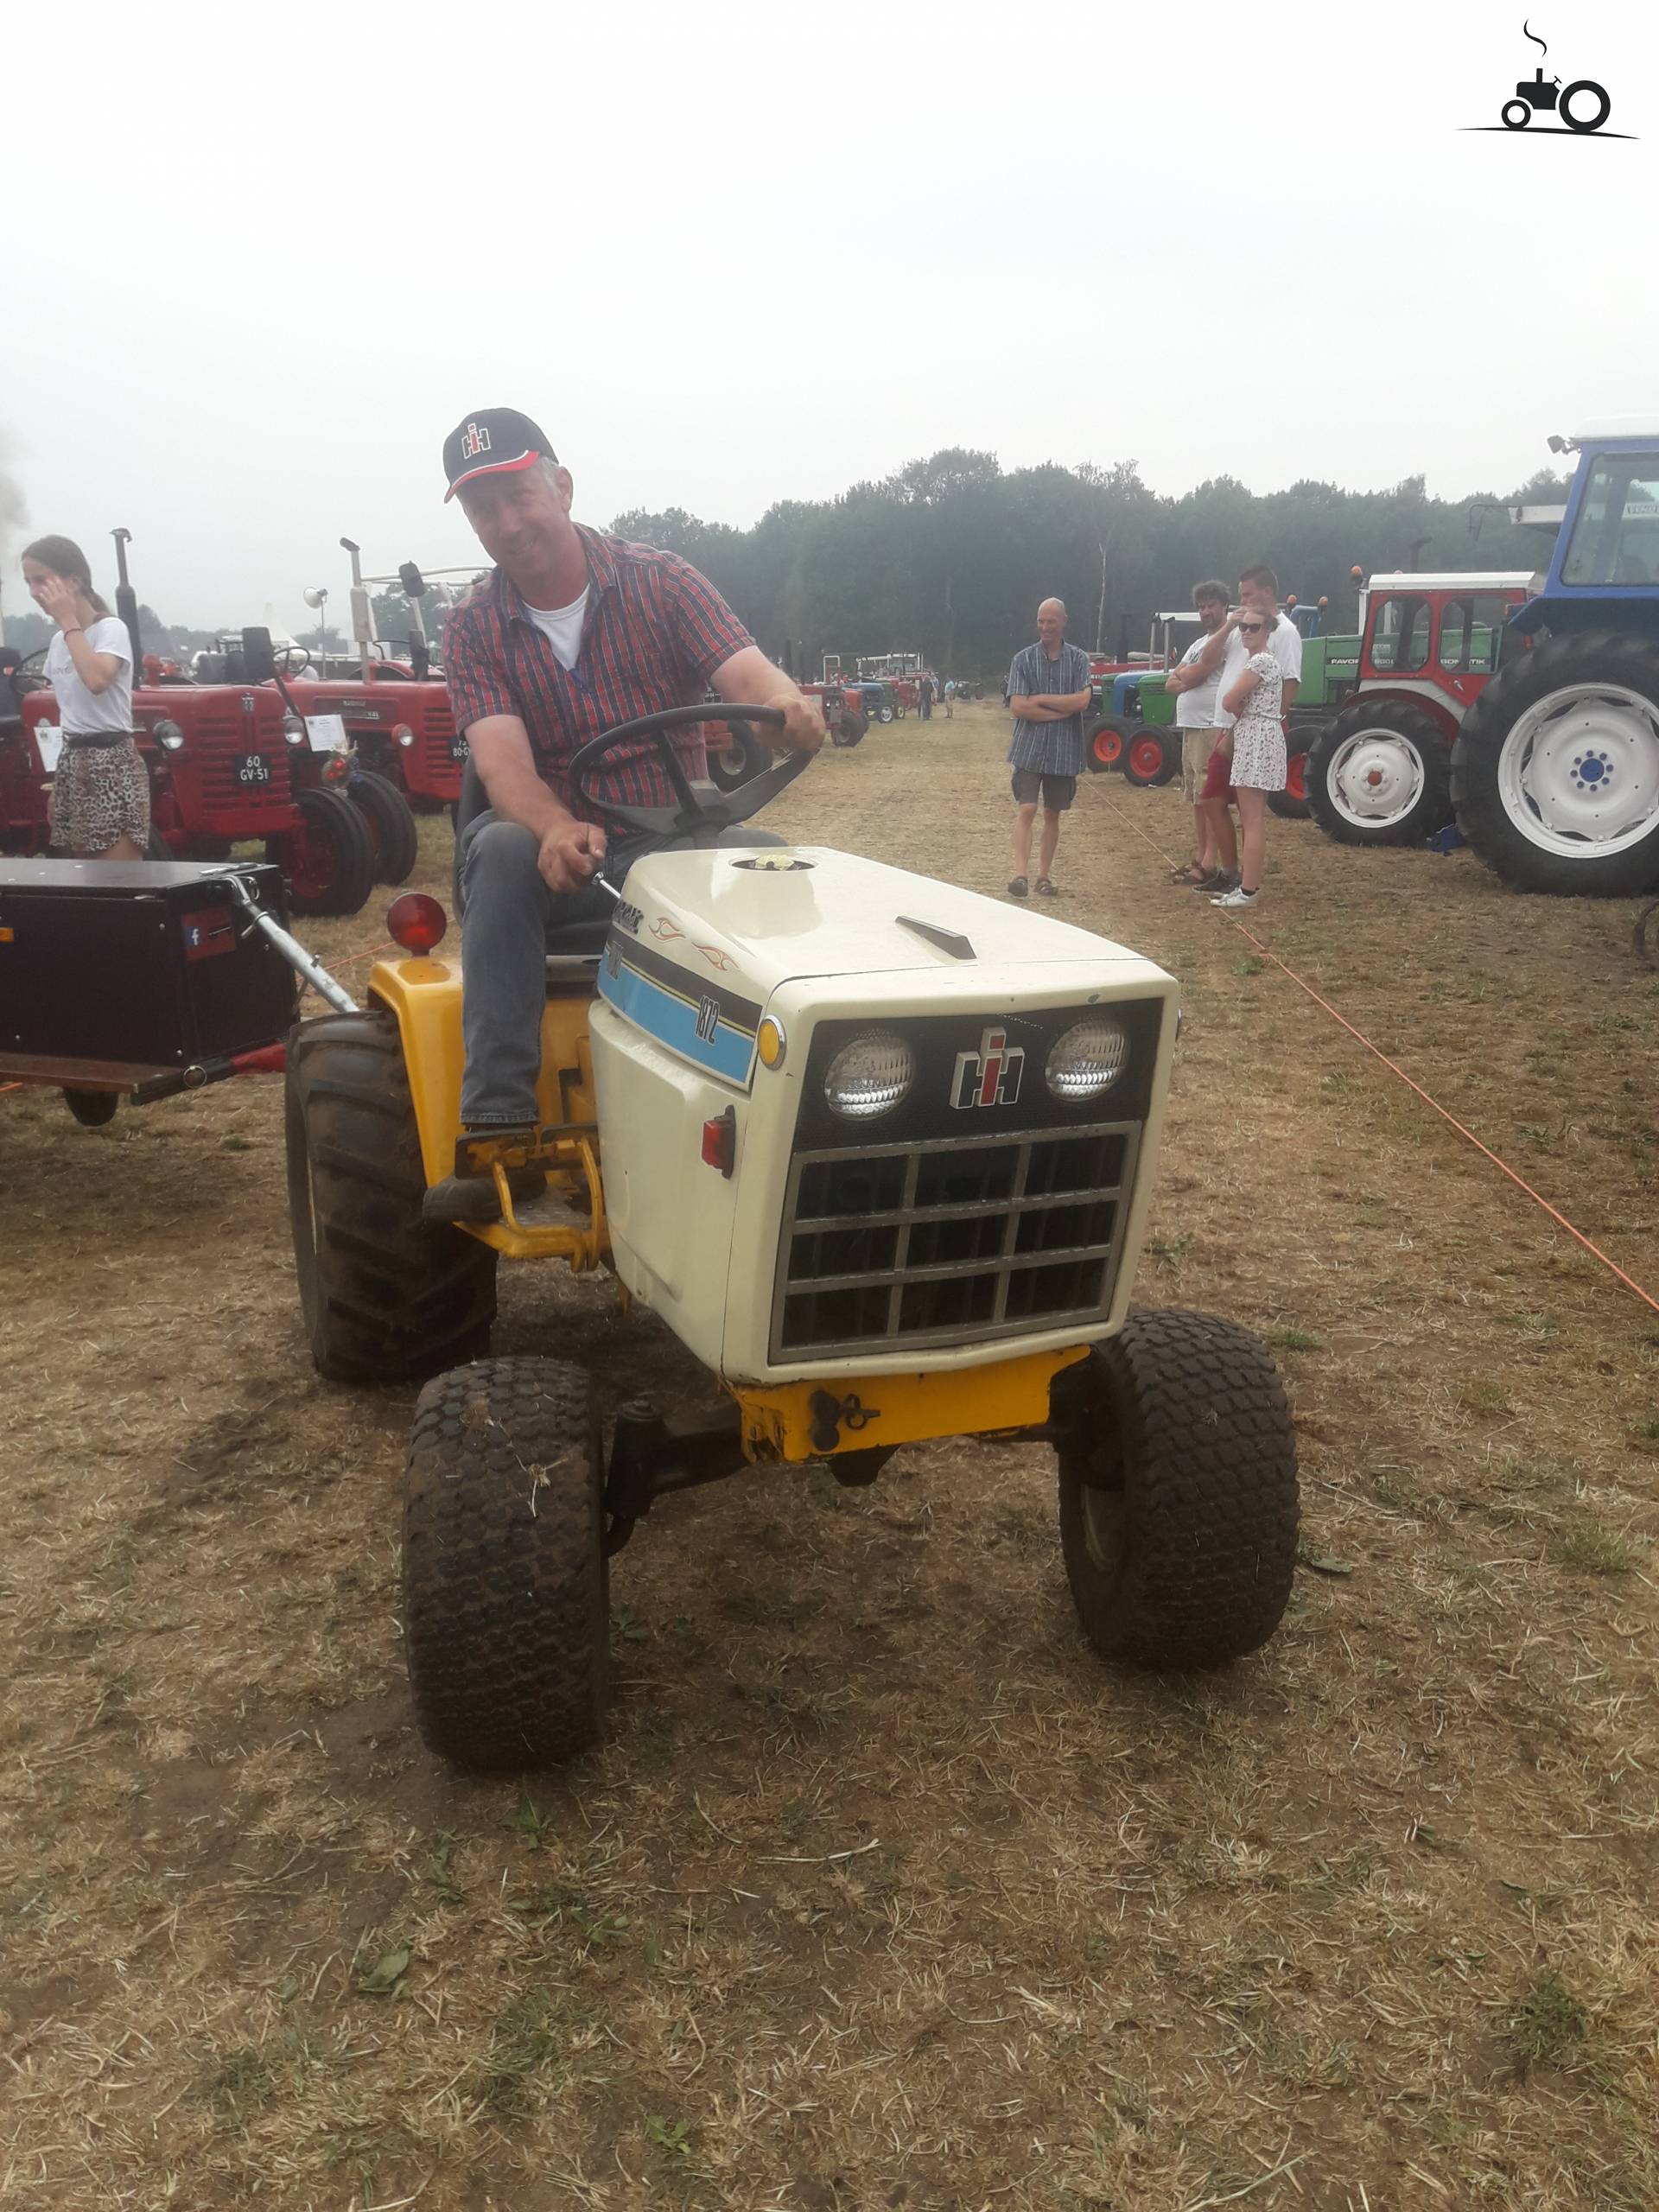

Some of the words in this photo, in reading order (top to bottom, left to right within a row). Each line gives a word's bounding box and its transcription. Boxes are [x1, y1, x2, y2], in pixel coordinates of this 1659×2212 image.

[246, 755, 260, 767] 60
[240, 768, 269, 781] GV-51
[695, 995, 720, 1046] 1872
